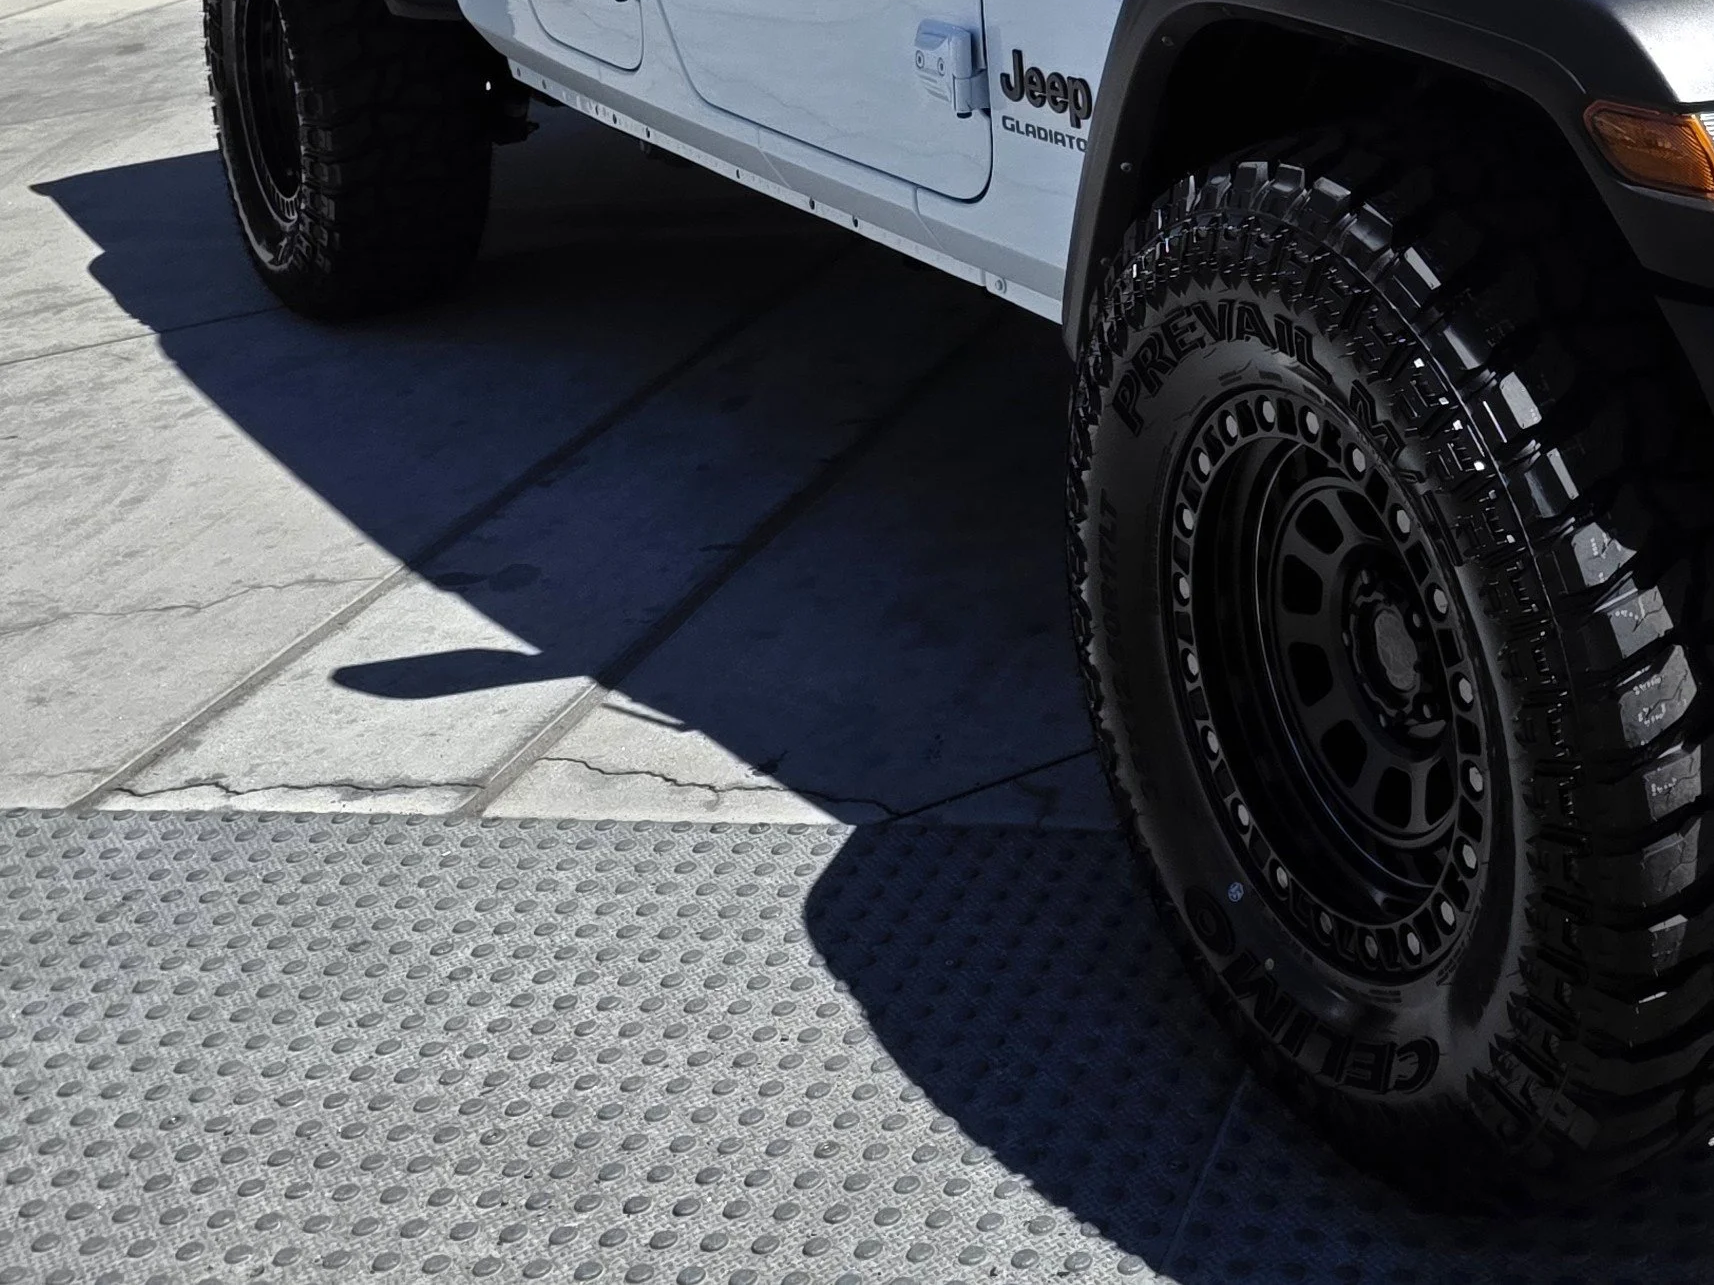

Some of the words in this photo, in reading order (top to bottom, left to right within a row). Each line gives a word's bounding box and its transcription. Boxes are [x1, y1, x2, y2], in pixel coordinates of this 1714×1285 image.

[1000, 49, 1092, 129] Jeep
[1002, 115, 1088, 152] GLADIATO
[1112, 298, 1332, 437] PREVAIL
[1185, 885, 1440, 1095] CELIMO
